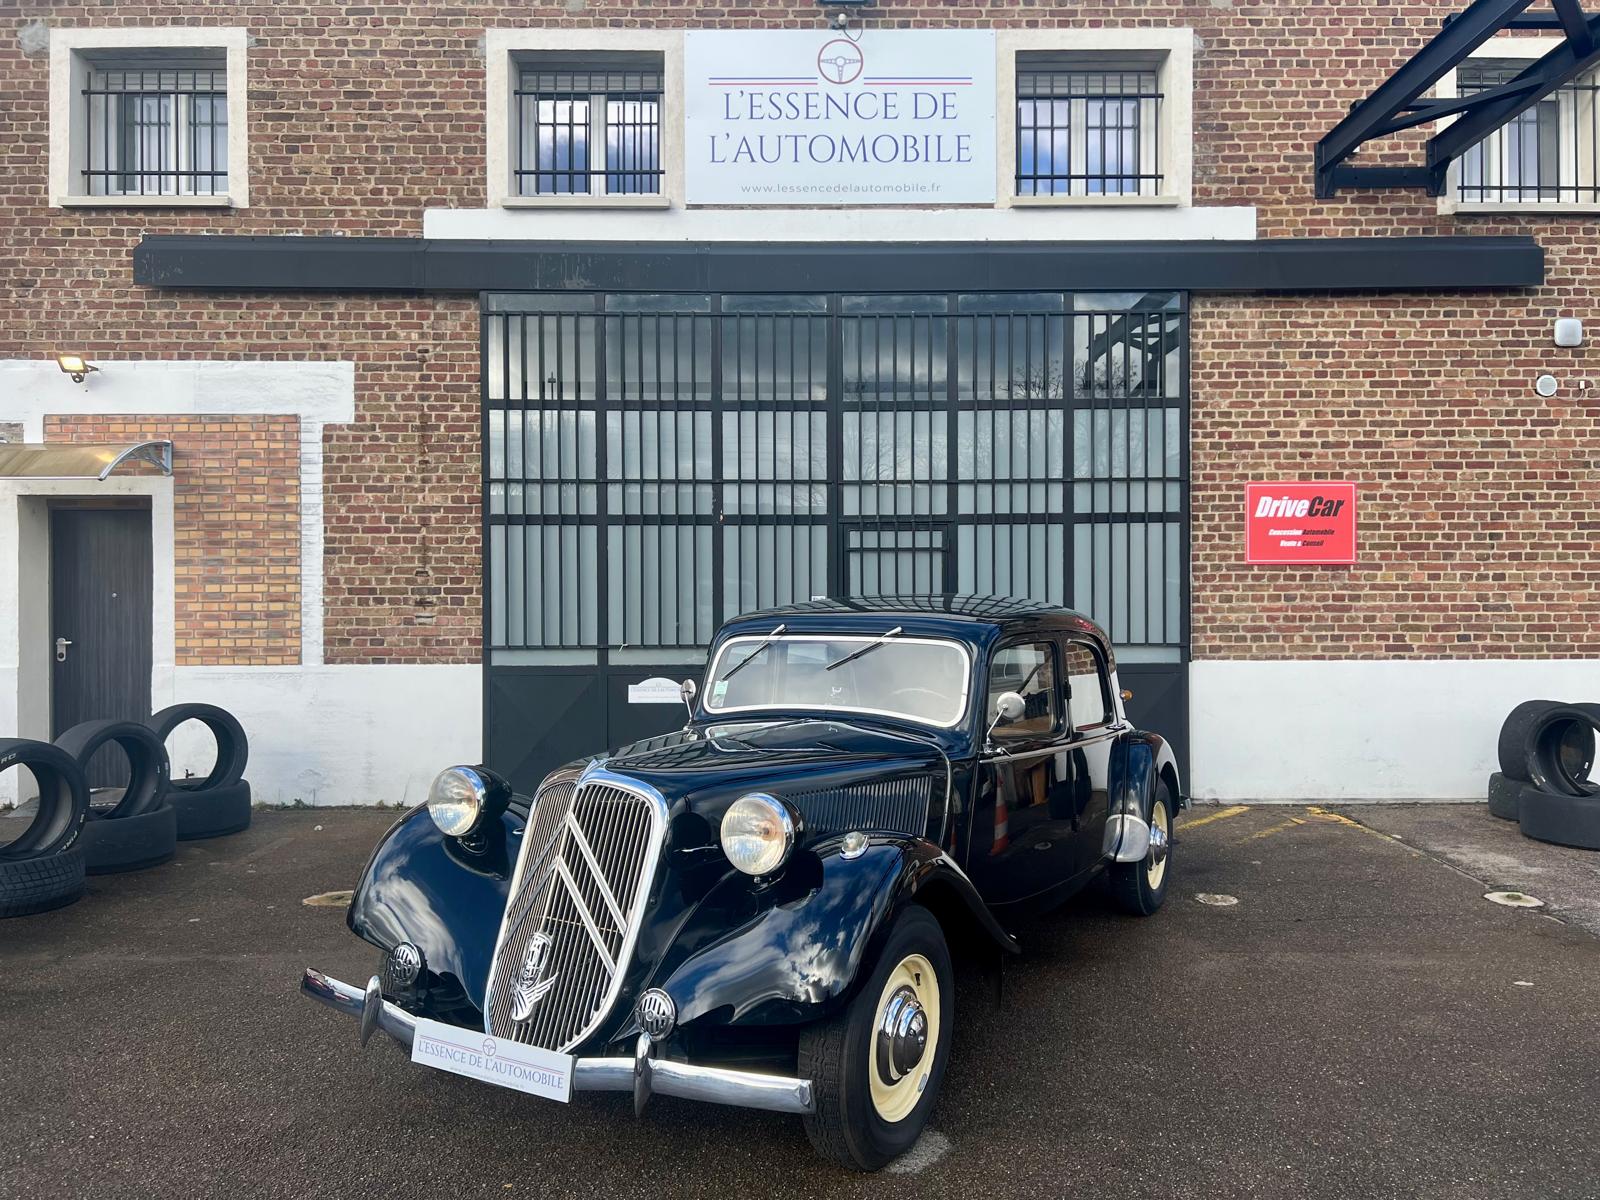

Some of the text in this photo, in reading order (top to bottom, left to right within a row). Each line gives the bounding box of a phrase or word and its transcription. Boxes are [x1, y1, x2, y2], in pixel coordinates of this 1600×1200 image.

[724, 90, 959, 120] L'ESSENCE DE
[709, 133, 973, 164] L'AUTOMOBILE
[741, 182, 942, 194] www.lessencedelautomobile.fr
[1254, 495, 1345, 518] DriveCar
[418, 1039, 467, 1063] L'ESSENCE
[469, 1054, 483, 1069] DE
[485, 1057, 564, 1090] L'AUTOMOBILE
